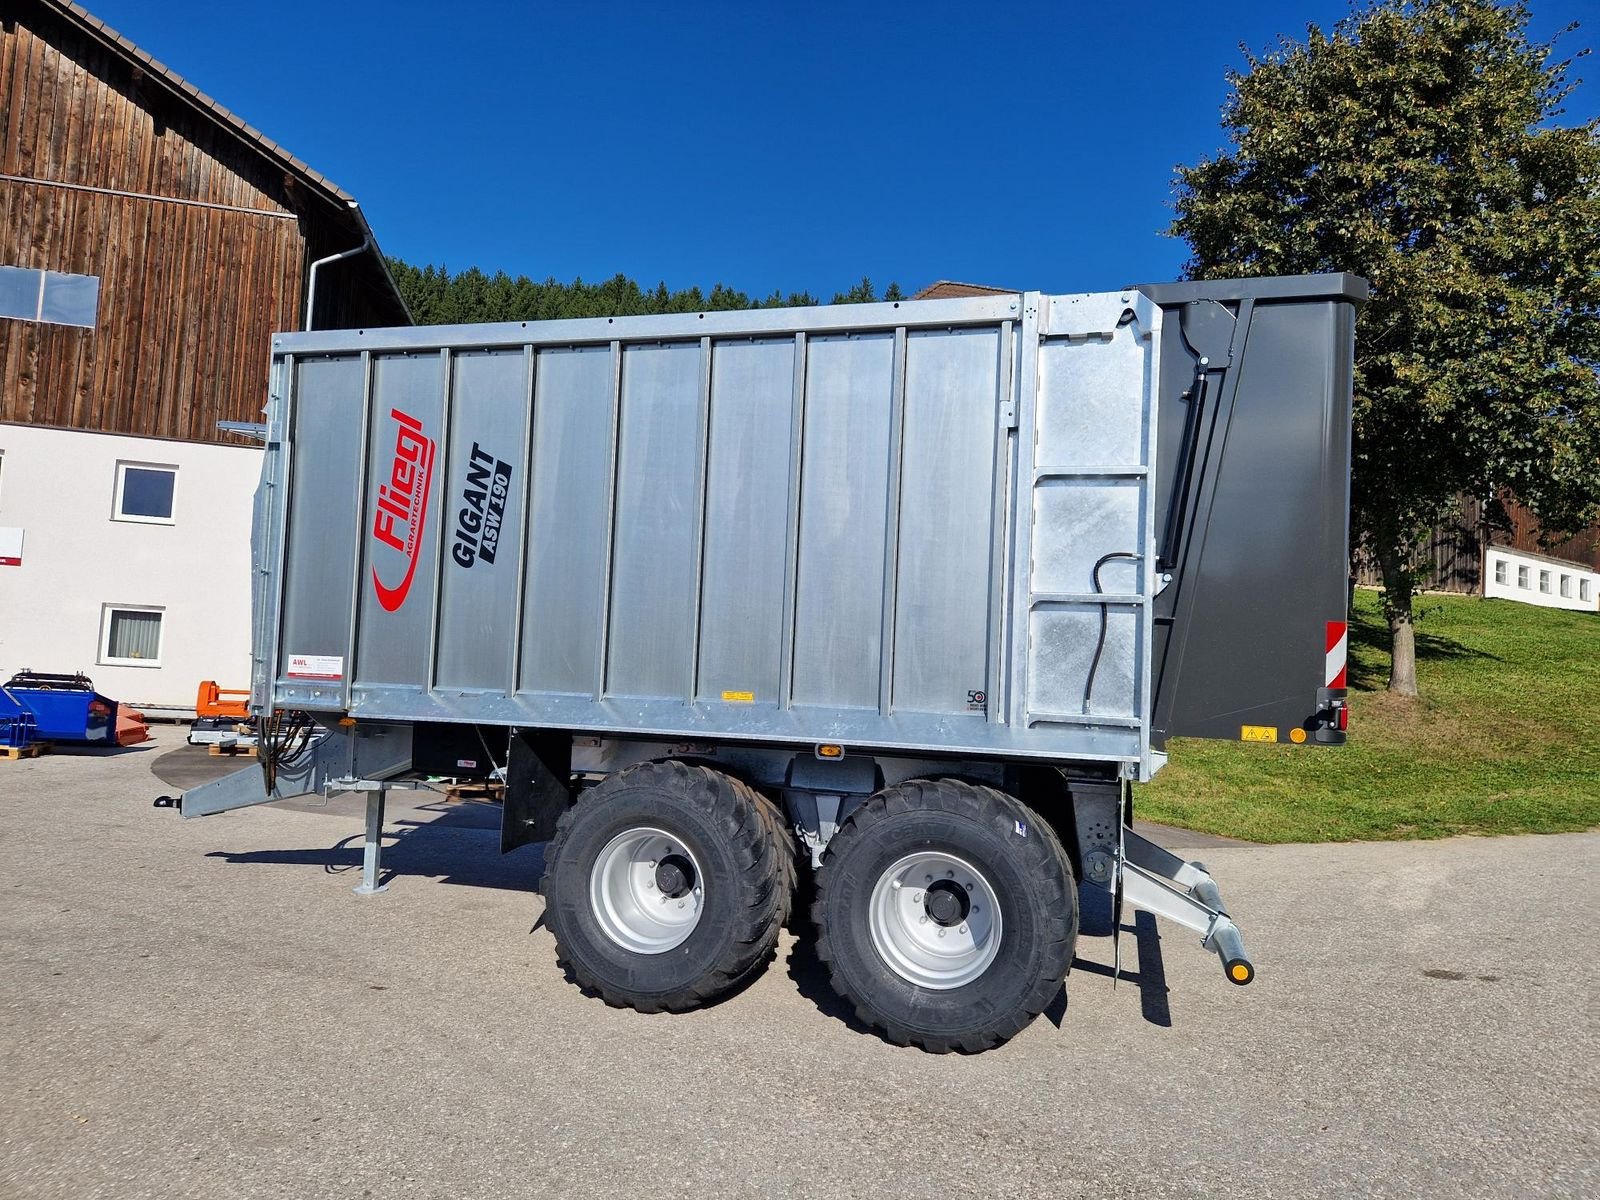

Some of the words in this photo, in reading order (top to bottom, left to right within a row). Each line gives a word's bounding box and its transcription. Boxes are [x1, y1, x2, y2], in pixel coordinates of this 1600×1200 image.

[374, 408, 428, 551] Fliegl
[406, 470, 425, 558] AGRARTECHNIK
[452, 441, 494, 569] GIGANT
[490, 472, 508, 509] 190
[482, 508, 500, 554] ASW
